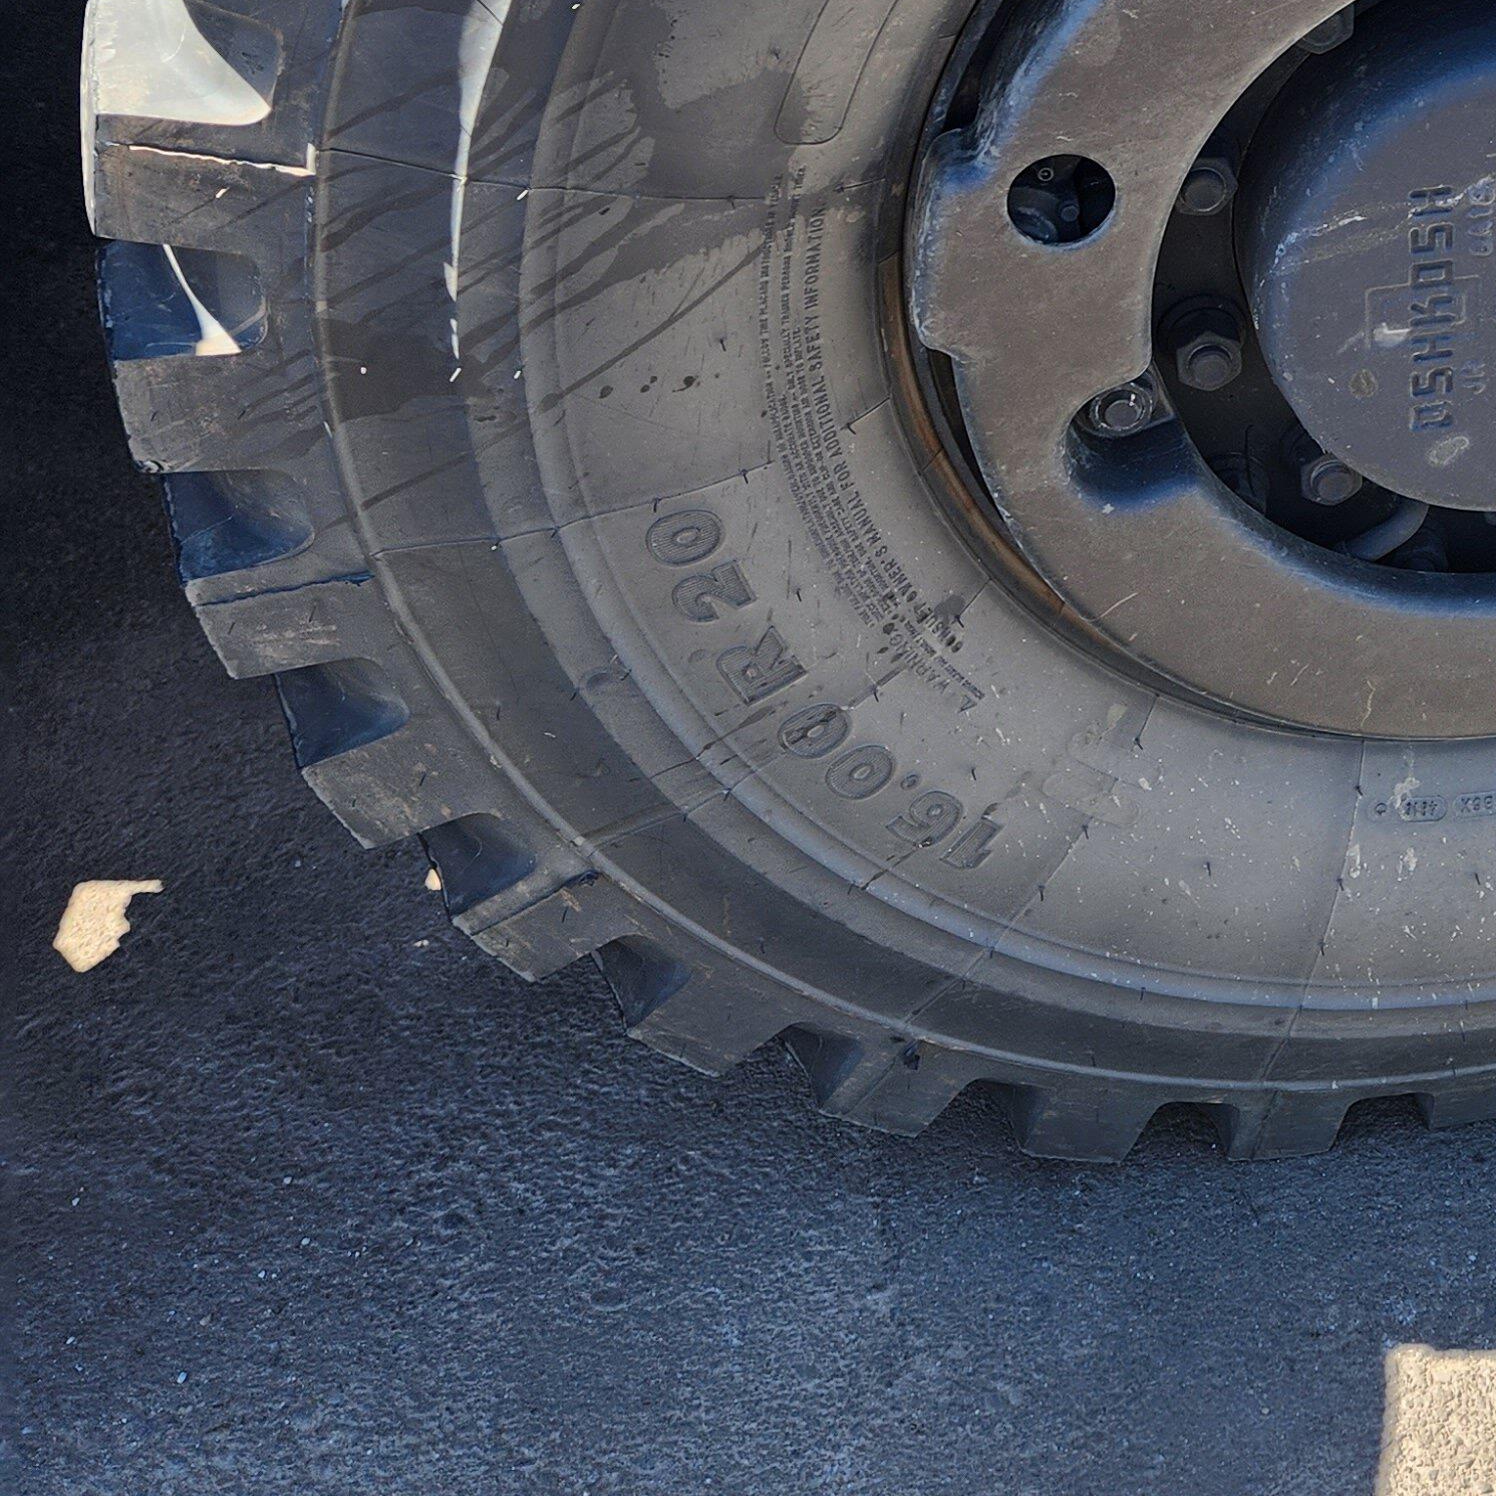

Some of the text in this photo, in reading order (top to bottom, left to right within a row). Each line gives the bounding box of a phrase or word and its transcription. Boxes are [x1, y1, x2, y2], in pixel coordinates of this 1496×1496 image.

[803, 315, 824, 371] SAFETY
[1408, 184, 1456, 433] OSHKOSH
[809, 374, 843, 458] ADDITIONAL
[831, 459, 855, 491] FOR
[843, 489, 882, 547] MANUAL
[645, 508, 758, 623] 20
[871, 542, 919, 607] OWNER'S
[714, 625, 807, 704] R
[778, 702, 1004, 870] 16.00
